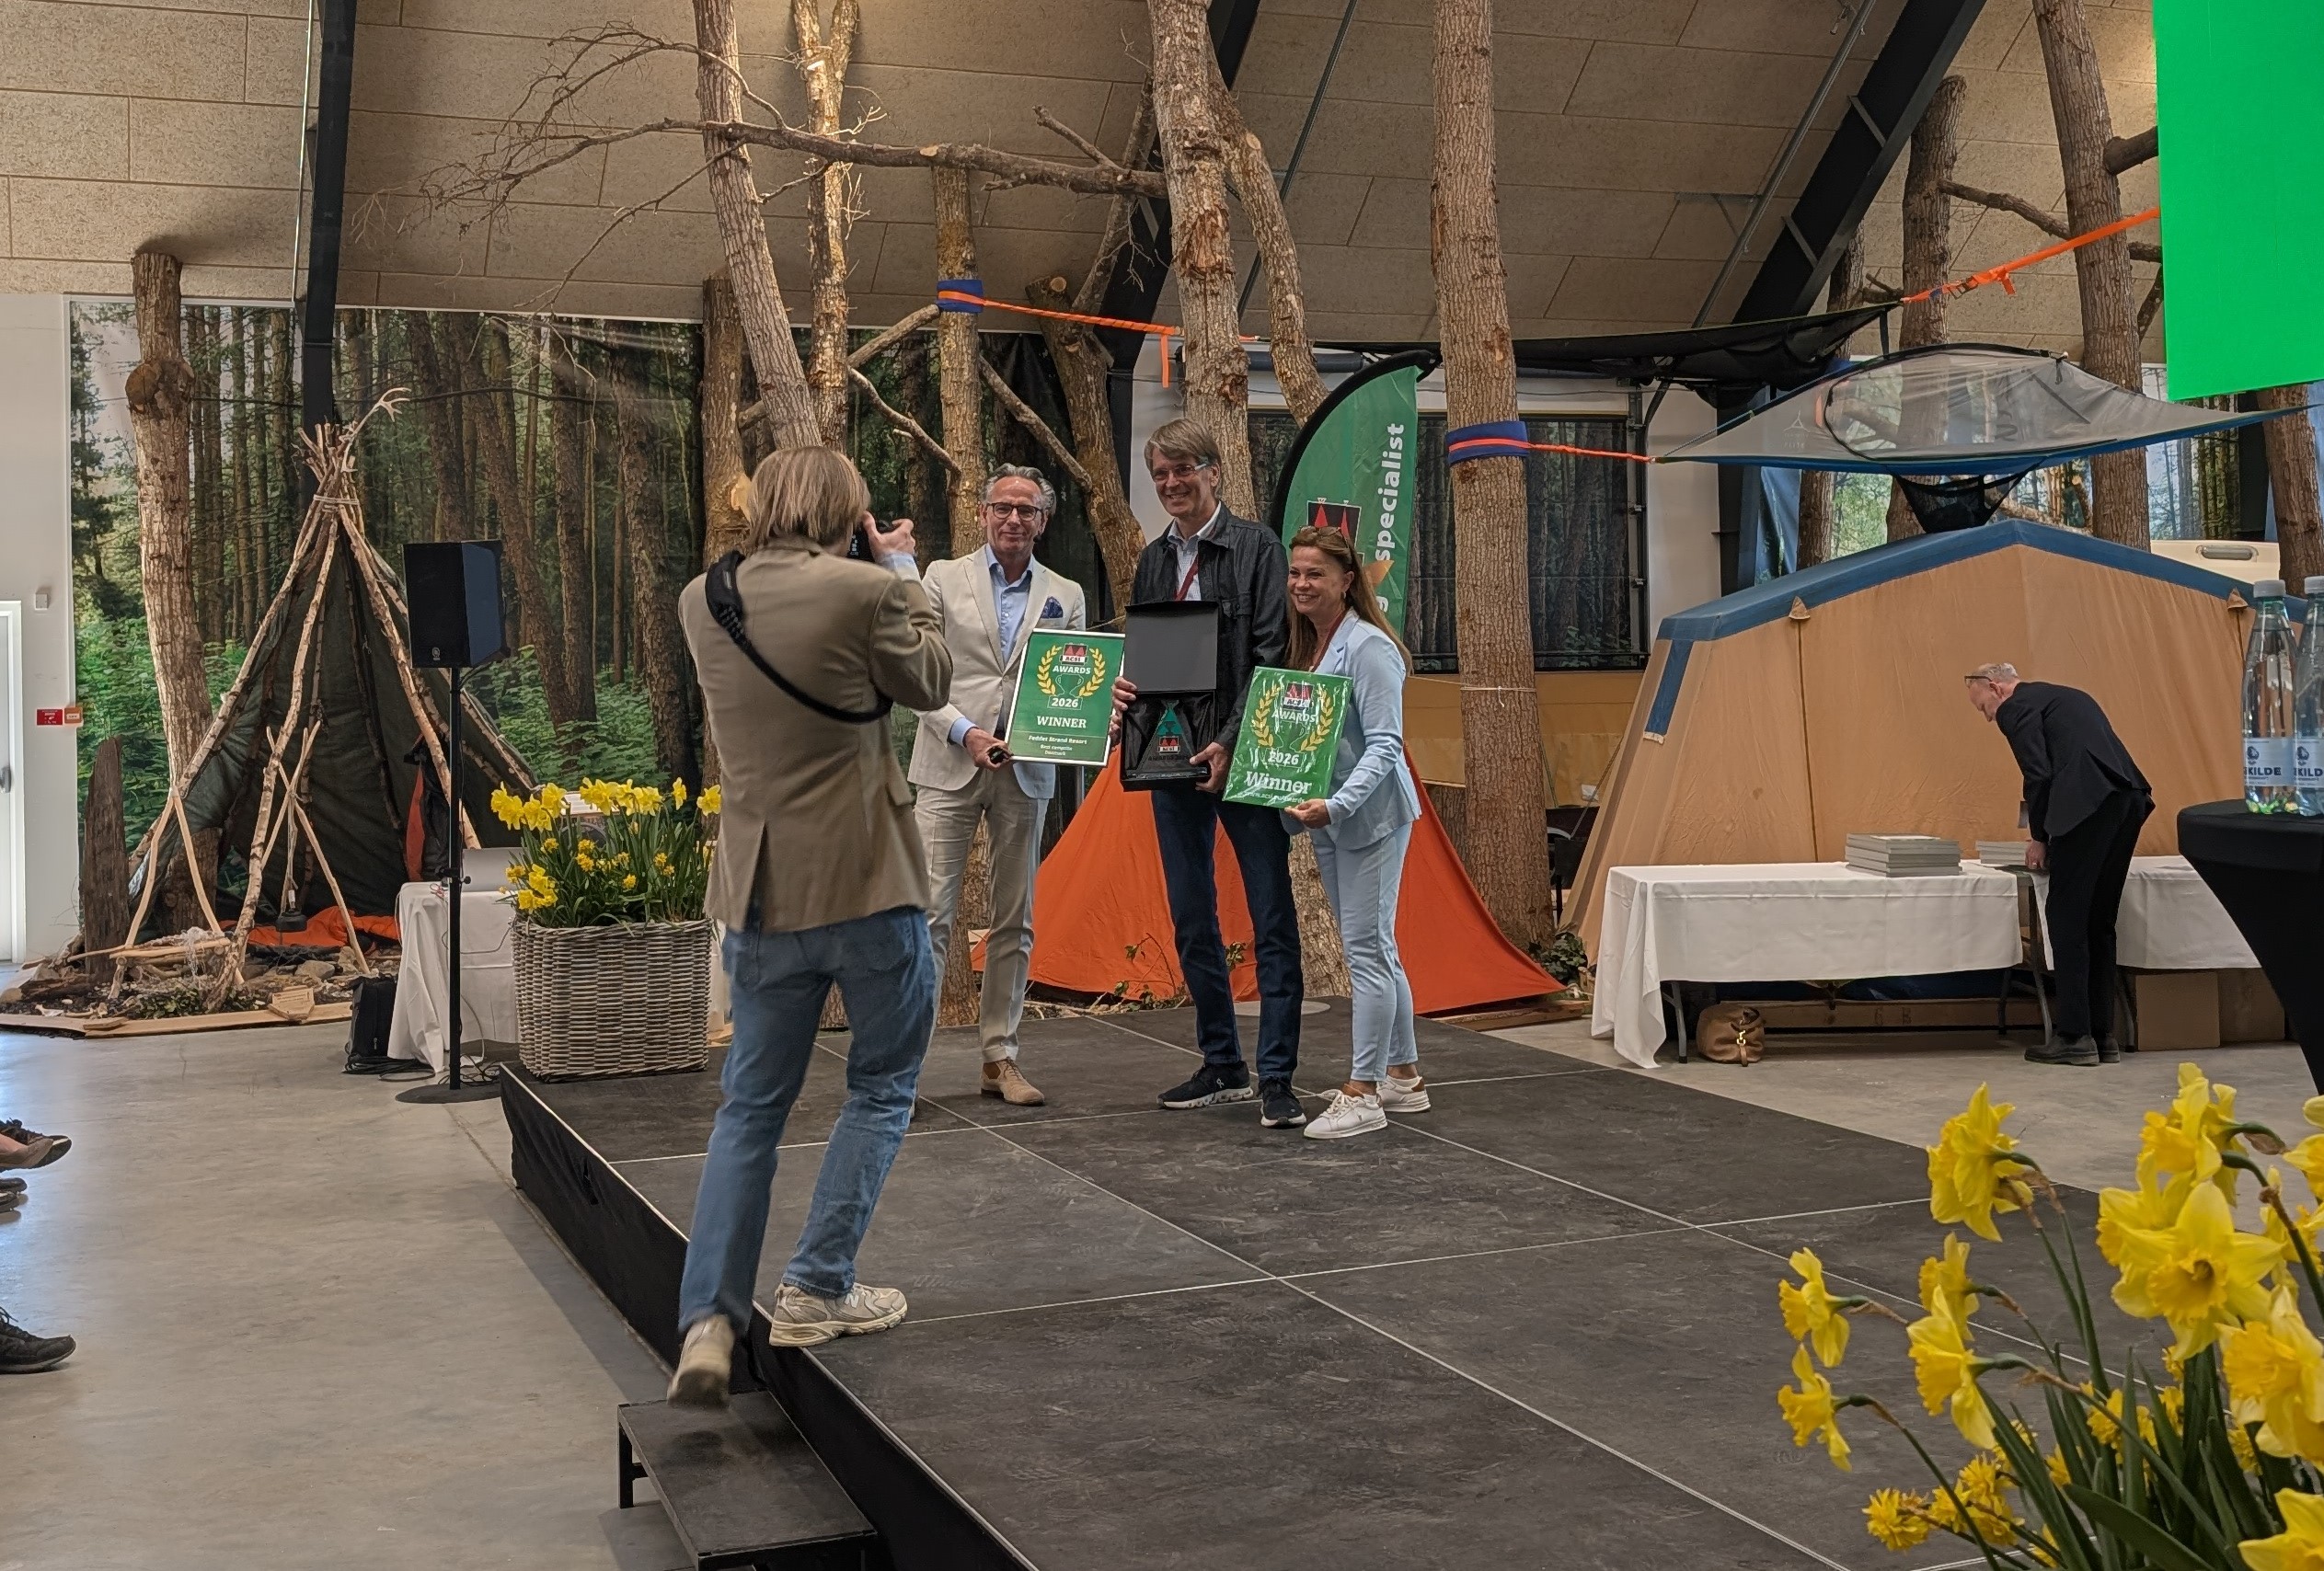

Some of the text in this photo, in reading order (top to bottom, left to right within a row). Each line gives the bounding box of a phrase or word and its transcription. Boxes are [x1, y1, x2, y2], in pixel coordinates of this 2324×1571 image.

[1375, 423, 1404, 561] specialist
[1053, 665, 1091, 675] AWARDS
[1051, 697, 1078, 708] 2026
[1036, 716, 1087, 728] WINNER
[1271, 710, 1316, 722] AWARDS
[1268, 751, 1300, 765] 2026
[1244, 771, 1313, 794] Winner
